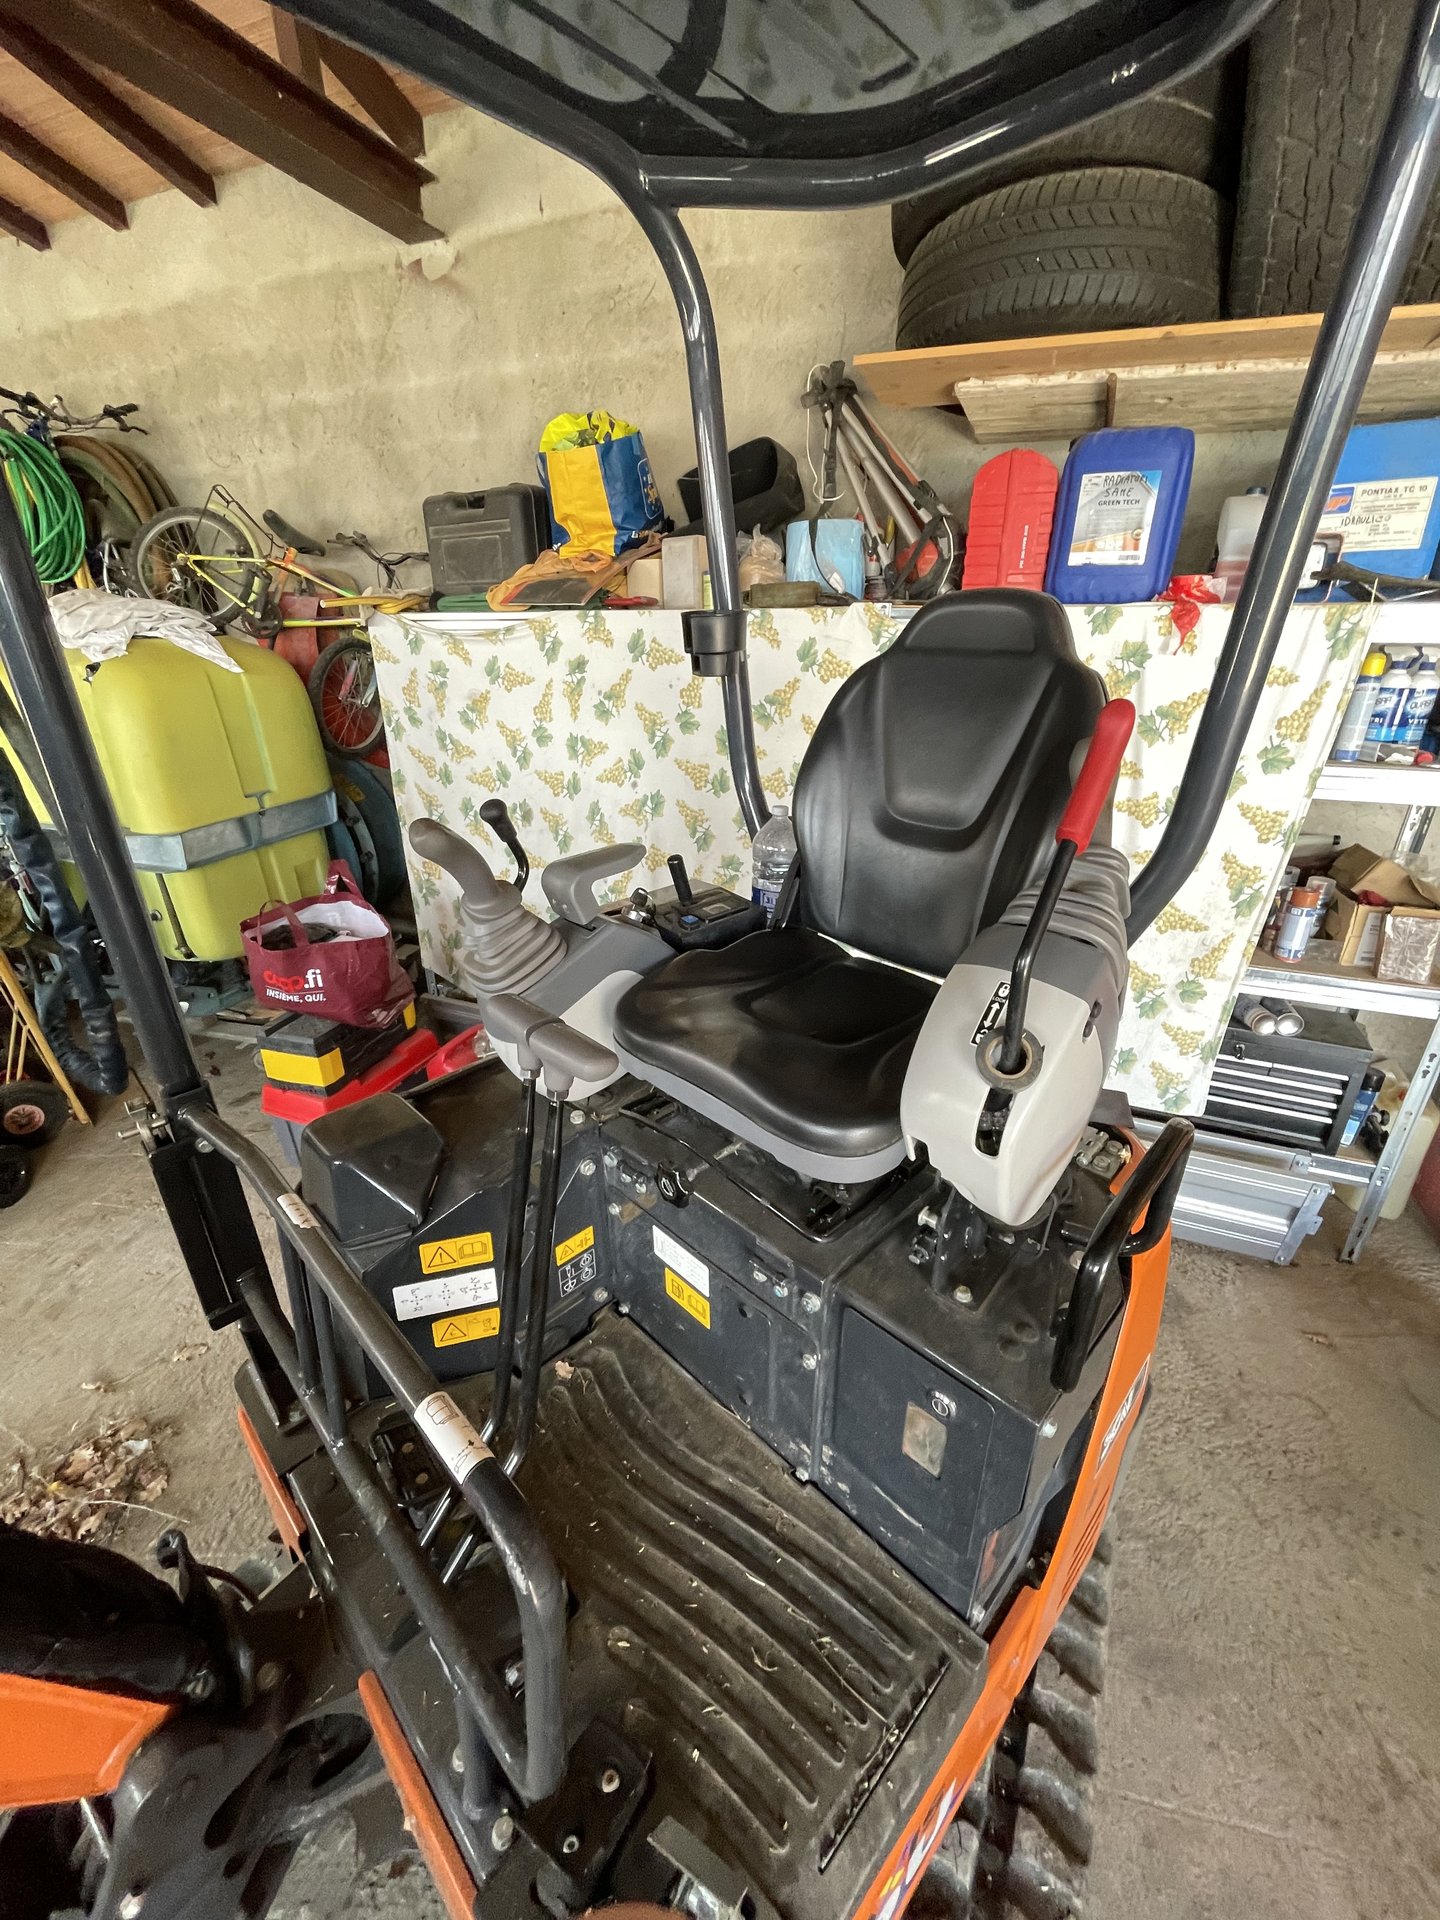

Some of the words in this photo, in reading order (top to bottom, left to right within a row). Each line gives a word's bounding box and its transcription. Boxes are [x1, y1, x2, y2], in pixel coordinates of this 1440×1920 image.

[1104, 487, 1134, 498] SAME
[1340, 514, 1392, 527] IDRAULICO
[266, 988, 303, 1003] INSIEME,
[304, 993, 327, 1002] QUI.
